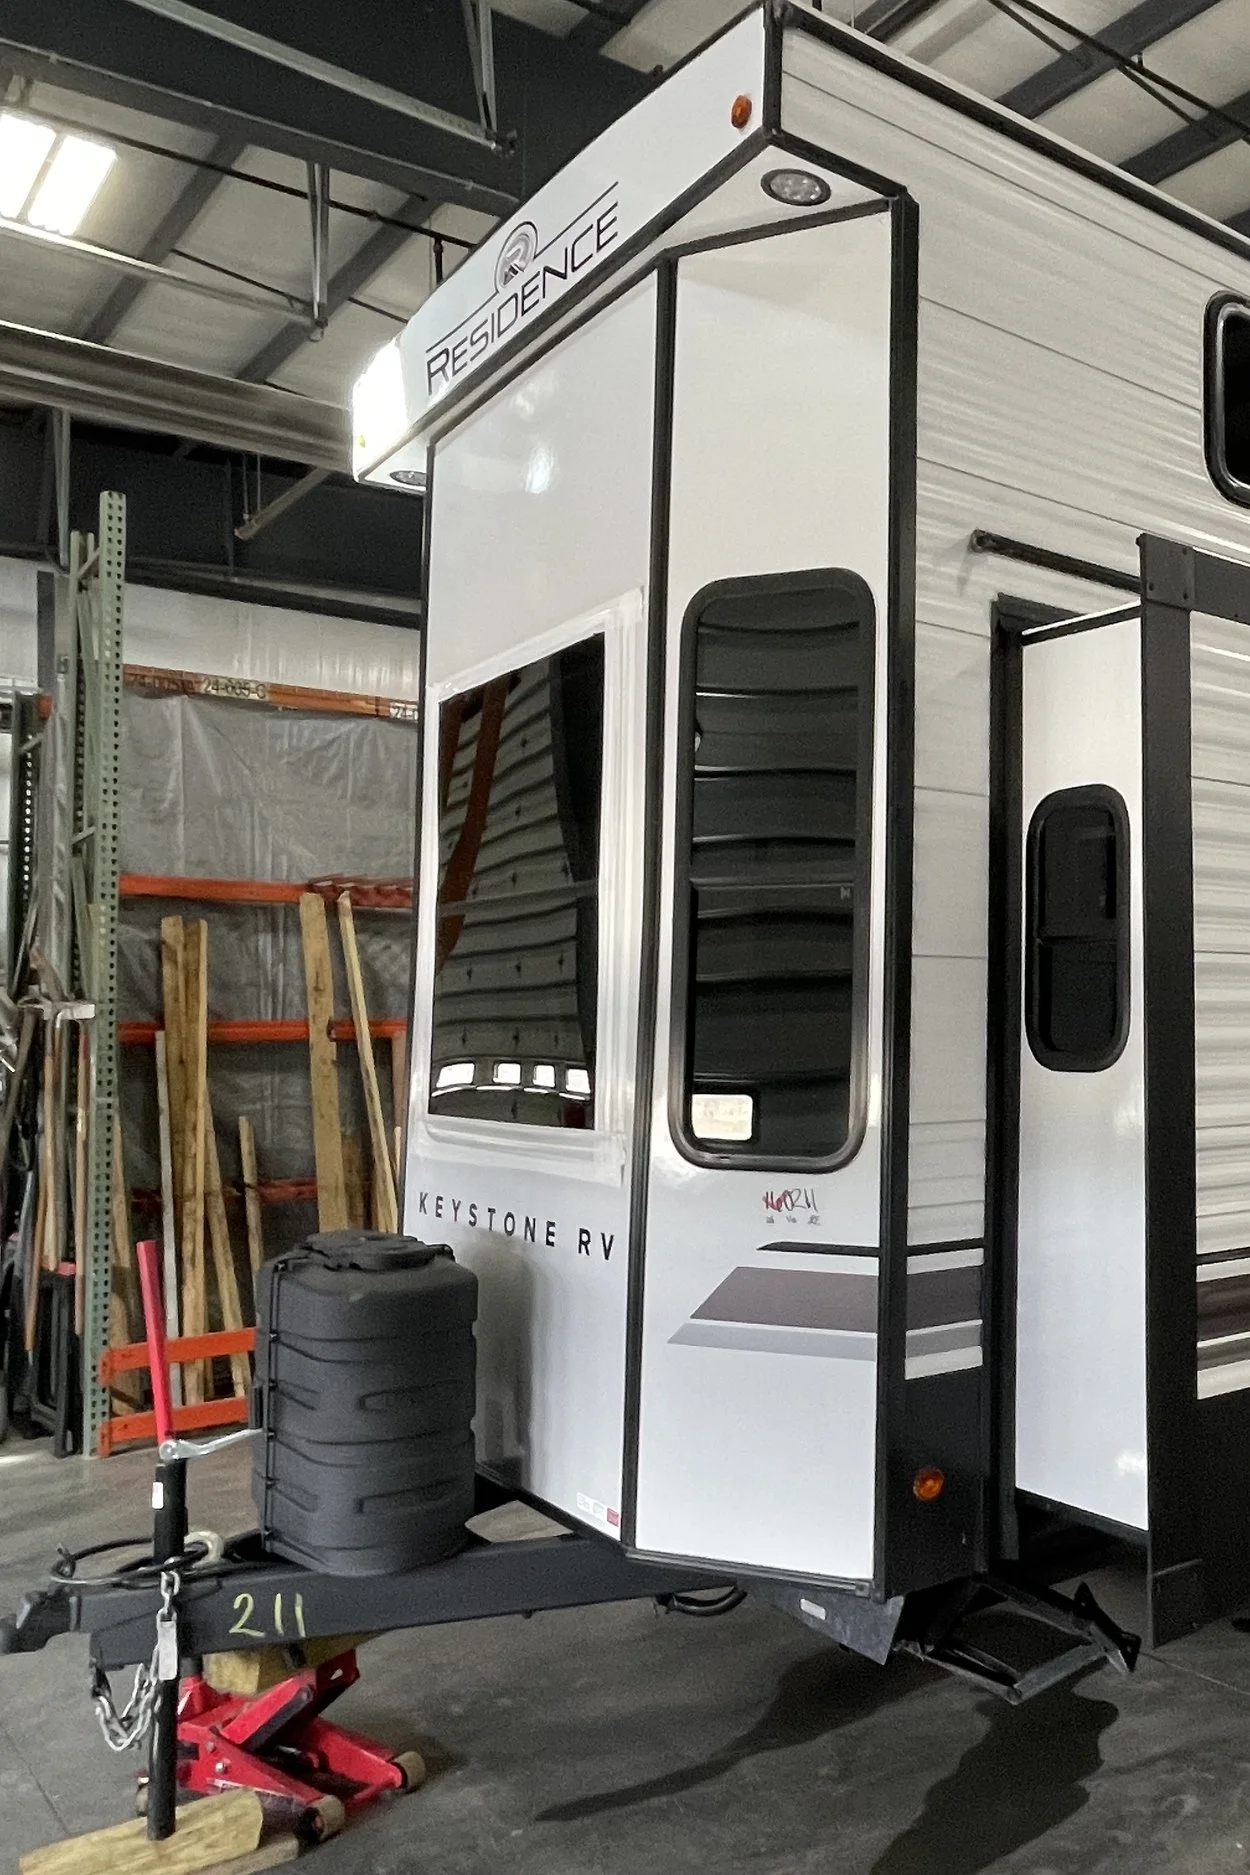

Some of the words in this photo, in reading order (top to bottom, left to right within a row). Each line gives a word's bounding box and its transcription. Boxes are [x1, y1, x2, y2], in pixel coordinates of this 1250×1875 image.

[426, 200, 619, 396] RESIDENCE
[418, 1191, 557, 1248] KEYSTONE
[577, 1227, 615, 1261] RV
[228, 1592, 307, 1638] 211
